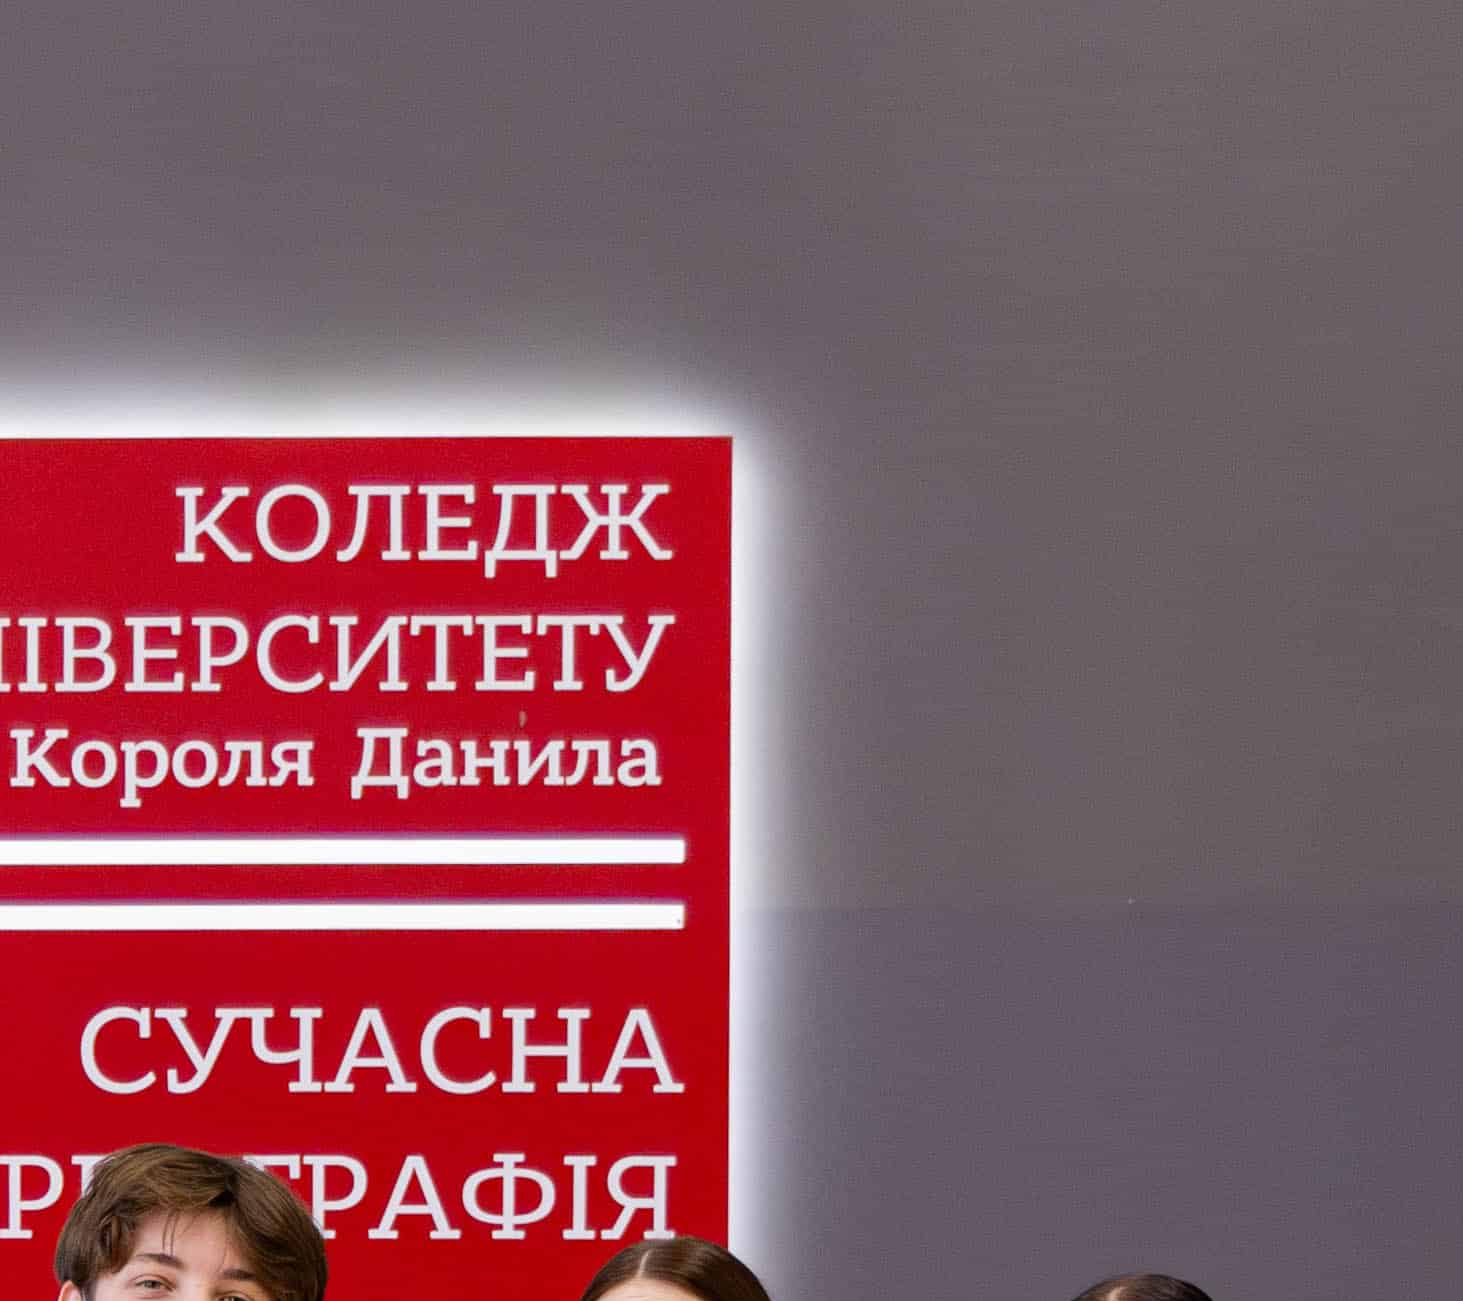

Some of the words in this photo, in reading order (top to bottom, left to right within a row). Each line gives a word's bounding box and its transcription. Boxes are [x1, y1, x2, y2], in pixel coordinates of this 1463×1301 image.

[174, 483, 673, 578] КОЛЕДЖ
[9, 727, 315, 808] Короля
[351, 726, 662, 800] Данила
[78, 1005, 686, 1095] СУЧАСНА
